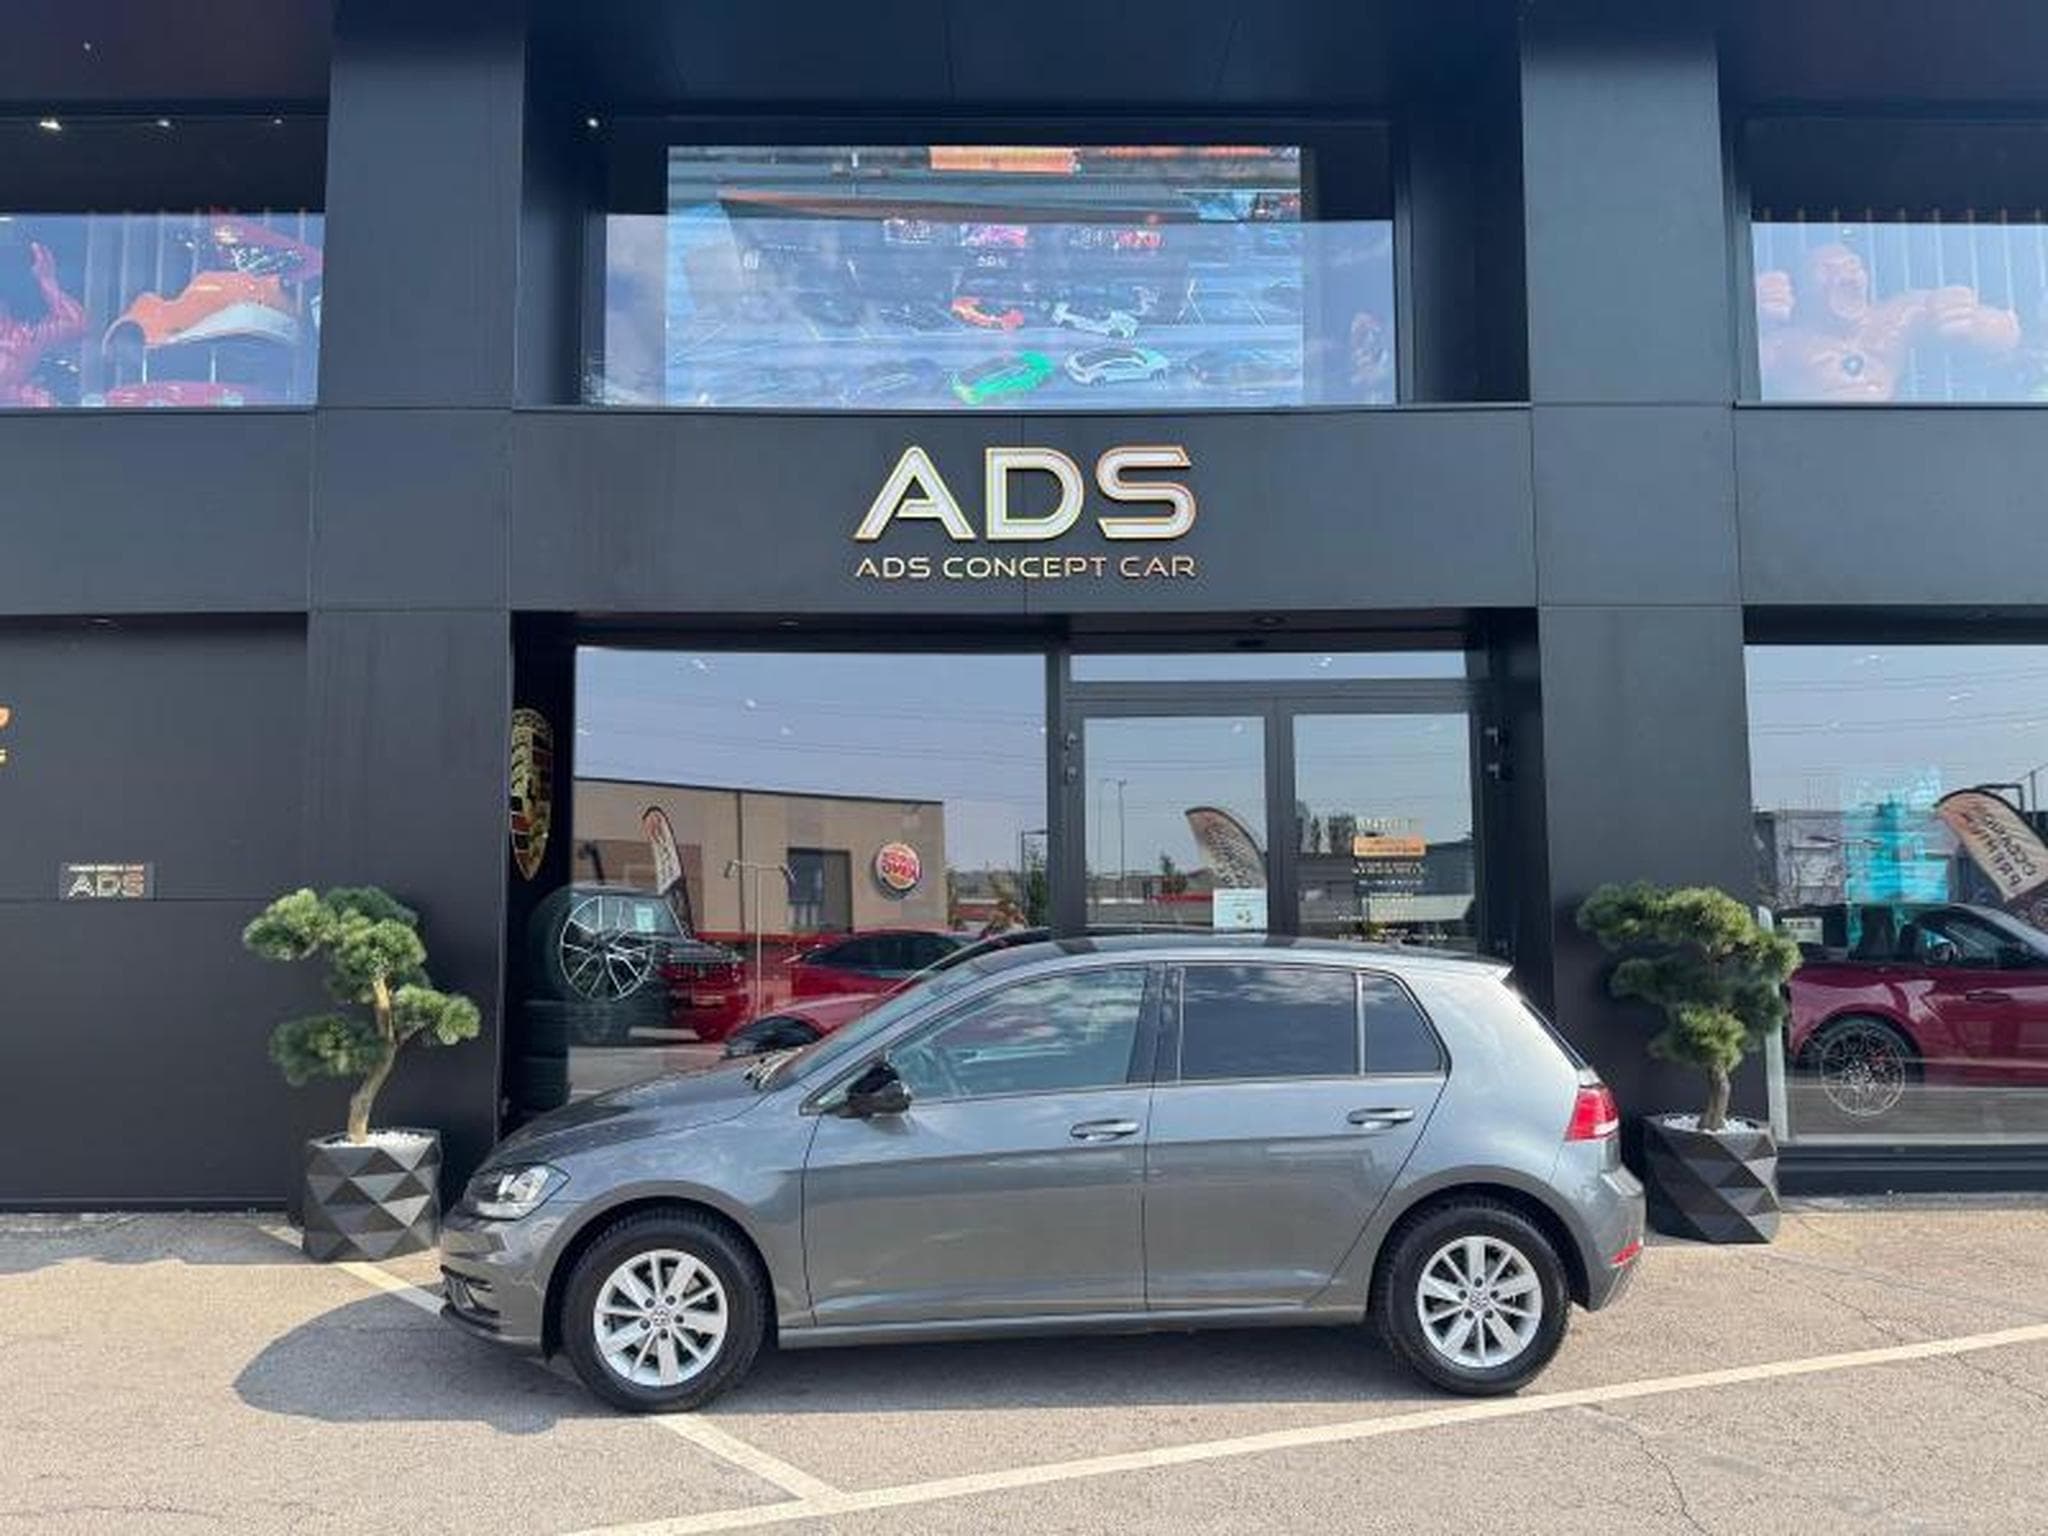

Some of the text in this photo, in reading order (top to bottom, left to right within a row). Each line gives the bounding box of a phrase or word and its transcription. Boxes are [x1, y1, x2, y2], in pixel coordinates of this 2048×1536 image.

[854, 446, 1197, 540] ADS
[855, 556, 1196, 579] ADS CONCEPT CAR
[68, 874, 145, 897] ADS
